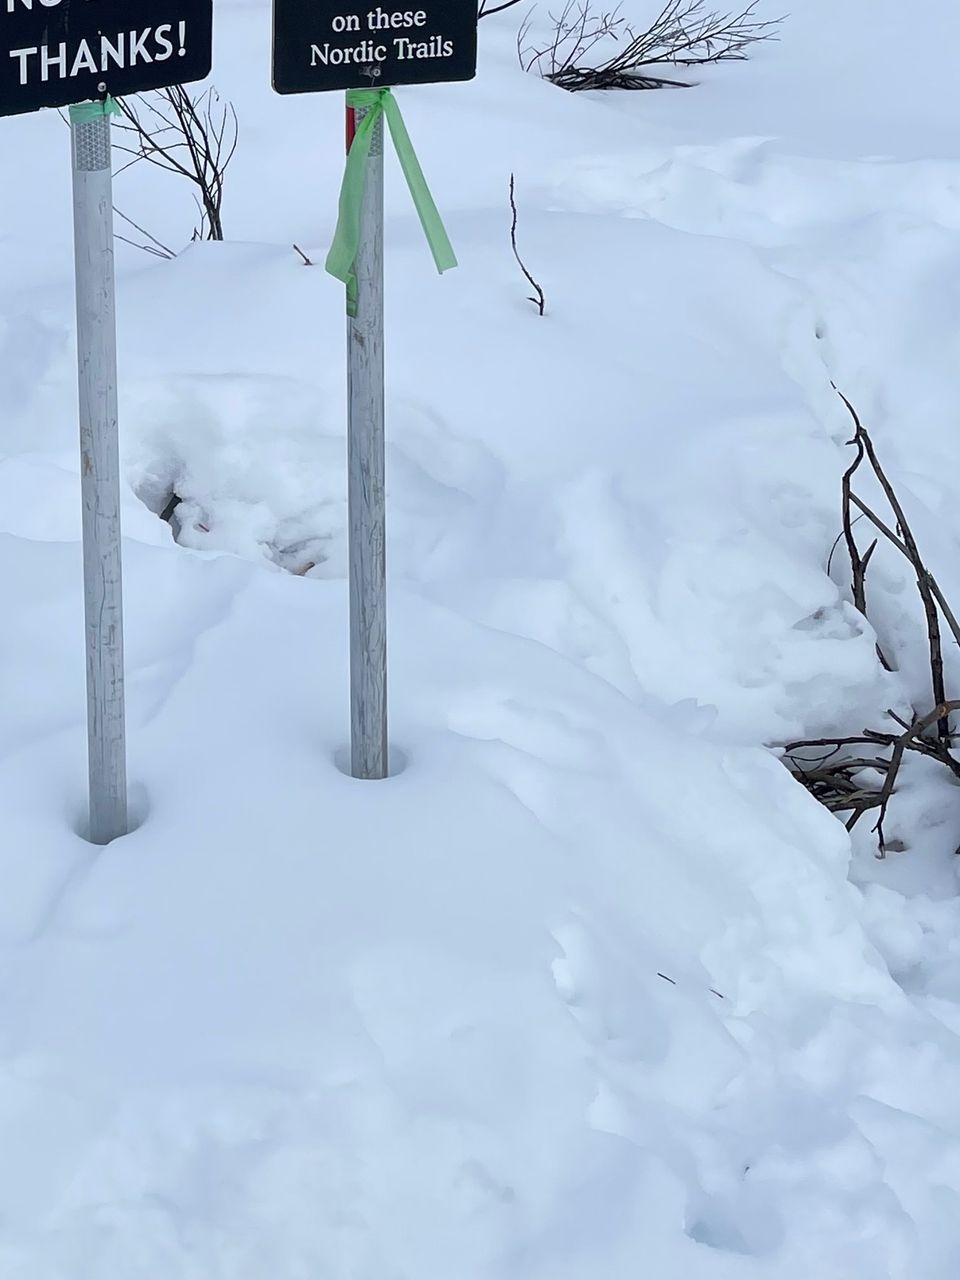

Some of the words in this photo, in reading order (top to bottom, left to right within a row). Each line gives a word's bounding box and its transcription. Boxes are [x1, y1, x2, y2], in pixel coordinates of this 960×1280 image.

[332, 14, 360, 32] on
[368, 7, 426, 29] these
[9, 21, 186, 85] THANKS!
[310, 41, 387, 66] Nordic
[394, 35, 453, 61] Trails
